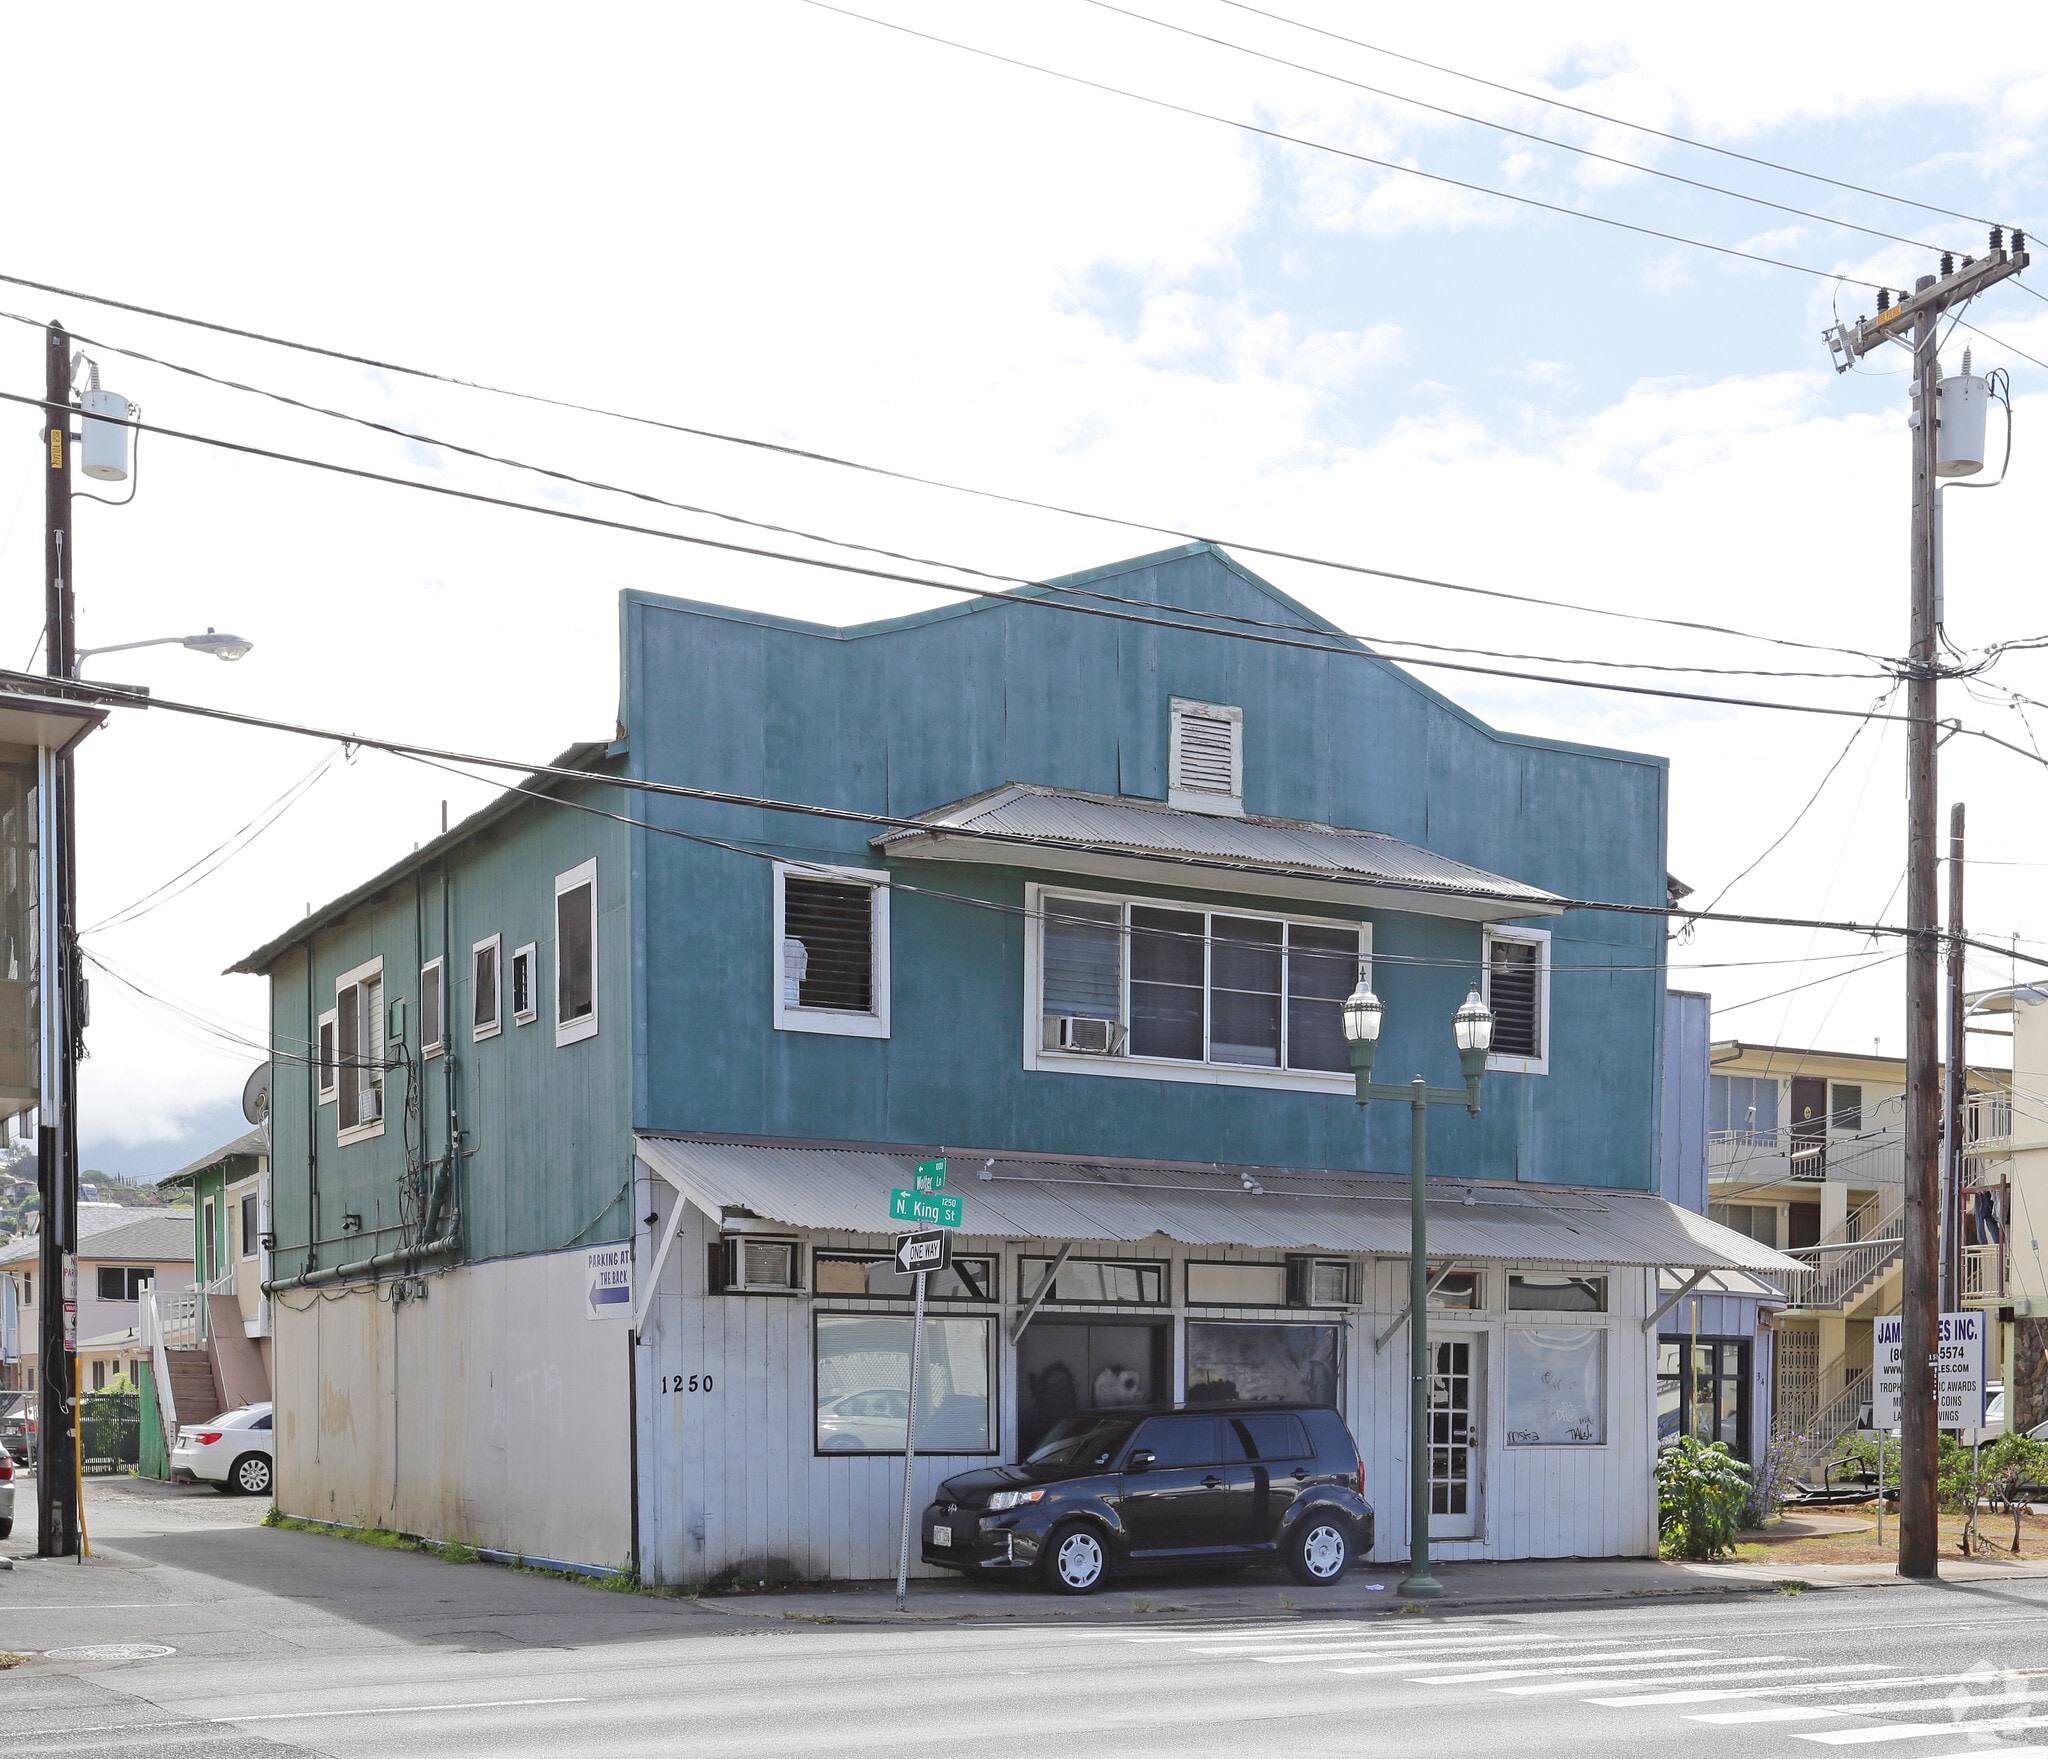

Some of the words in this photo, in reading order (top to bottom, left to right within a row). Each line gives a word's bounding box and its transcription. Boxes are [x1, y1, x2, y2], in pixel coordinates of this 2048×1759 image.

[897, 1199, 907, 1215] N.
[913, 1201, 939, 1223] King
[945, 1209, 955, 1222] St
[942, 1198, 957, 1208] 1250
[588, 1252, 618, 1268] PARKING
[620, 1250, 630, 1265] AT
[910, 1243, 923, 1260] ONE
[925, 1242, 938, 1258] WAY
[600, 1271, 611, 1286] THE
[612, 1270, 628, 1285] BACK
[1878, 1323, 1902, 1344] JAM
[1954, 1318, 1978, 1341] INC.
[1939, 1346, 1965, 1360] 5574
[661, 1374, 714, 1395] 1250
[1879, 1382, 1902, 1393] TROPH
[1947, 1381, 1977, 1392] AWARDS
[1941, 1396, 1962, 1407] COINS
[1938, 1410, 1959, 1422] VINGS
